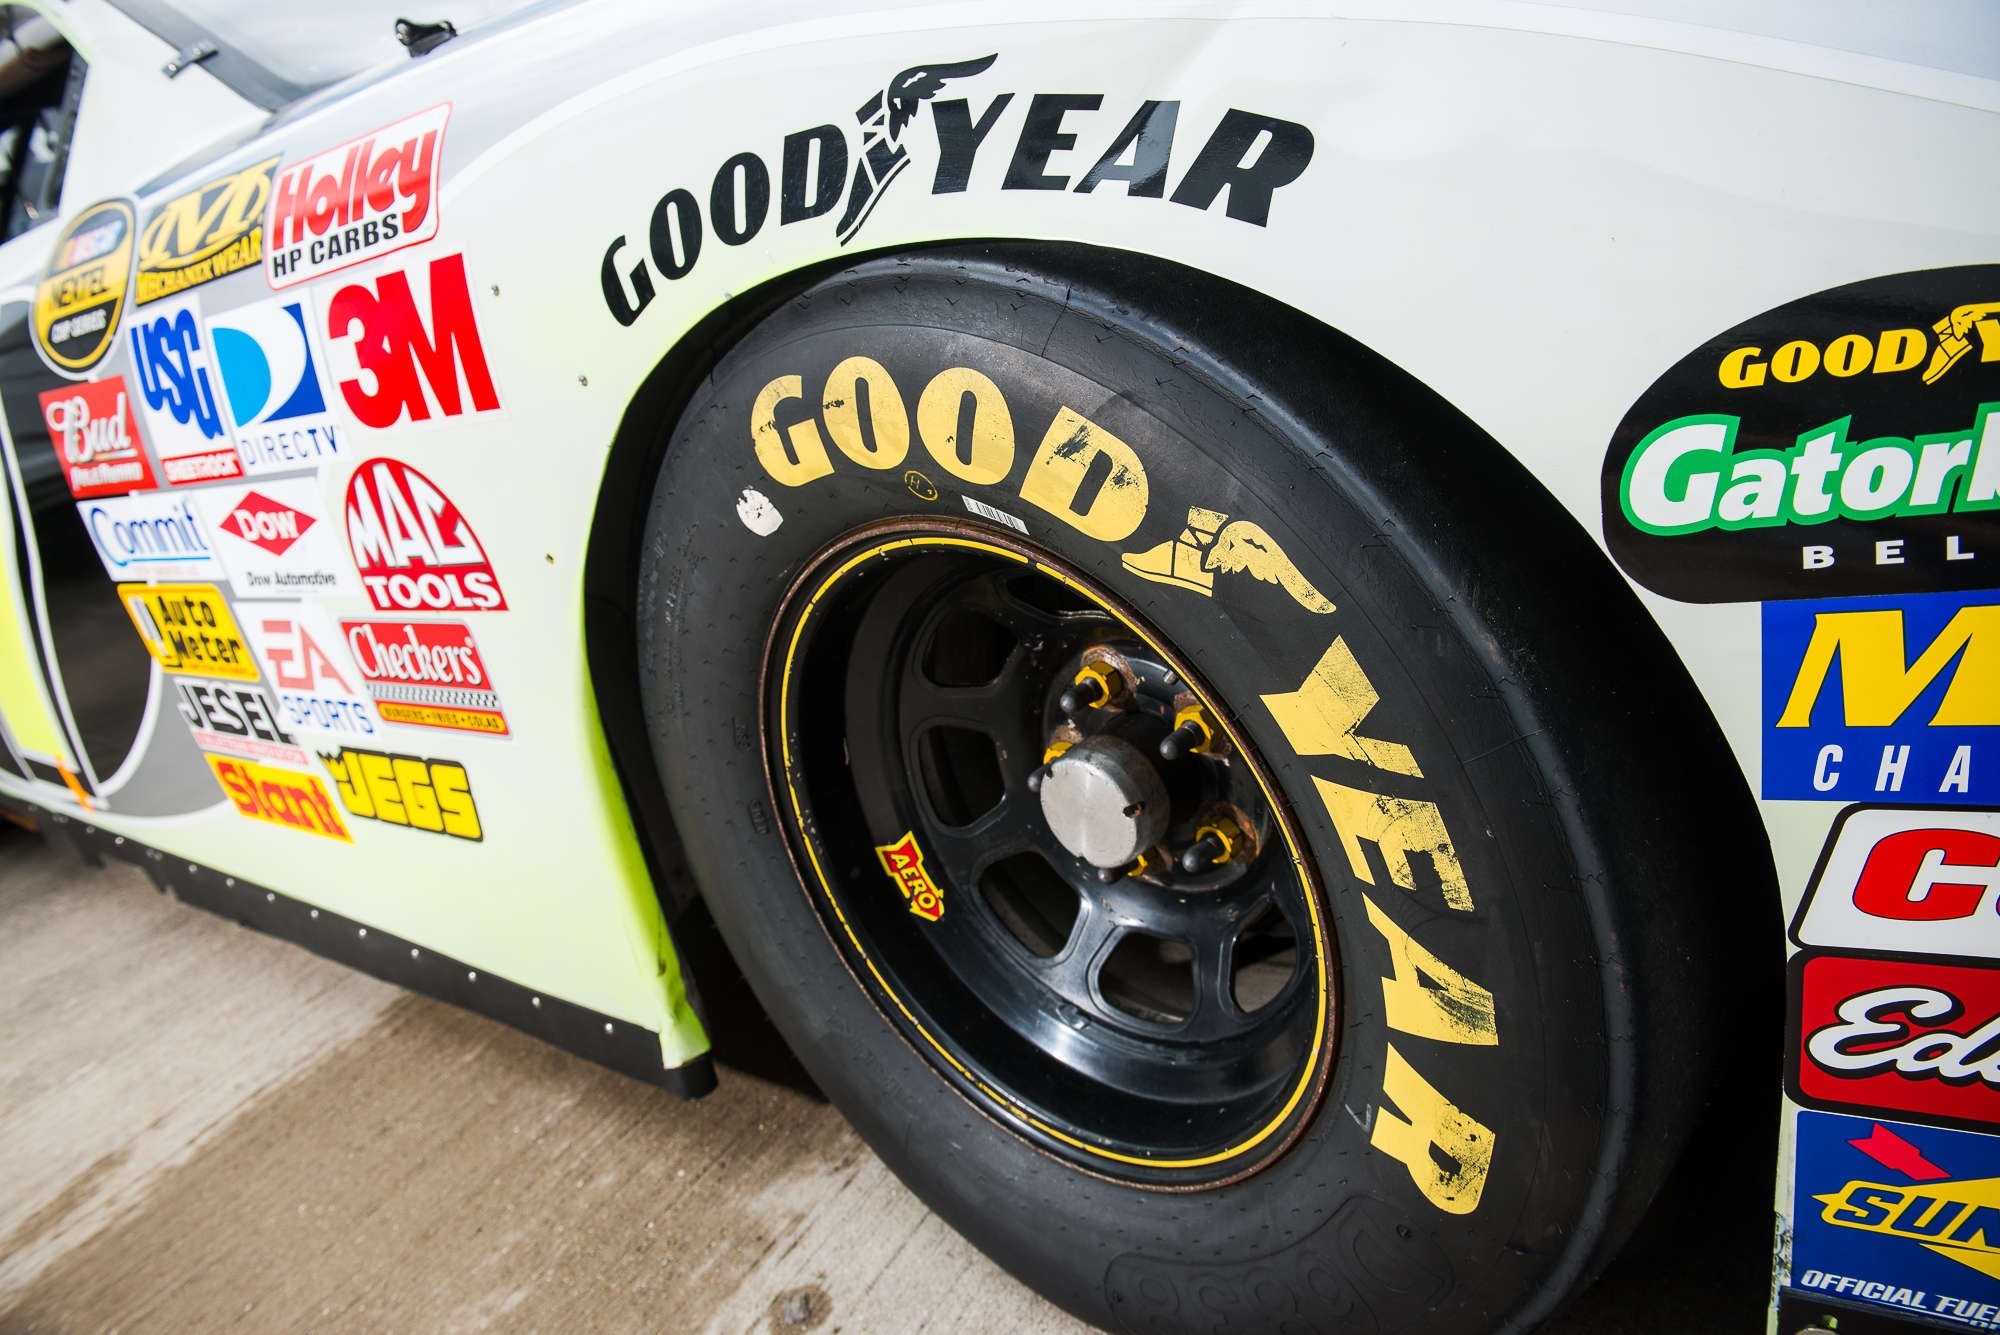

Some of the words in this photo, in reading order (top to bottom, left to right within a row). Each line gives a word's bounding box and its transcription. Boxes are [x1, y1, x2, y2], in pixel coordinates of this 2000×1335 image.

[273, 129, 438, 251] Holley
[273, 246, 302, 278] HP
[310, 213, 398, 265] CARBS
[328, 252, 500, 428] 3M
[131, 309, 224, 439] USG
[46, 392, 134, 464] Bud
[242, 424, 337, 466] DIRECTV
[90, 499, 209, 567] Commit
[232, 509, 300, 542] DOW
[347, 462, 486, 570] MAC
[276, 571, 336, 588] Automotive
[363, 572, 501, 610] TOOLS
[158, 596, 217, 628] Auto
[169, 630, 240, 664] Meter
[262, 620, 355, 694] EA
[349, 624, 482, 686] Checkers
[178, 682, 298, 746] JESEL
[283, 695, 374, 734] SPORTS
[317, 746, 483, 842] JEGS
[890, 854, 937, 909] AERO
[1801, 1269, 1927, 1309] OFFICIAL
